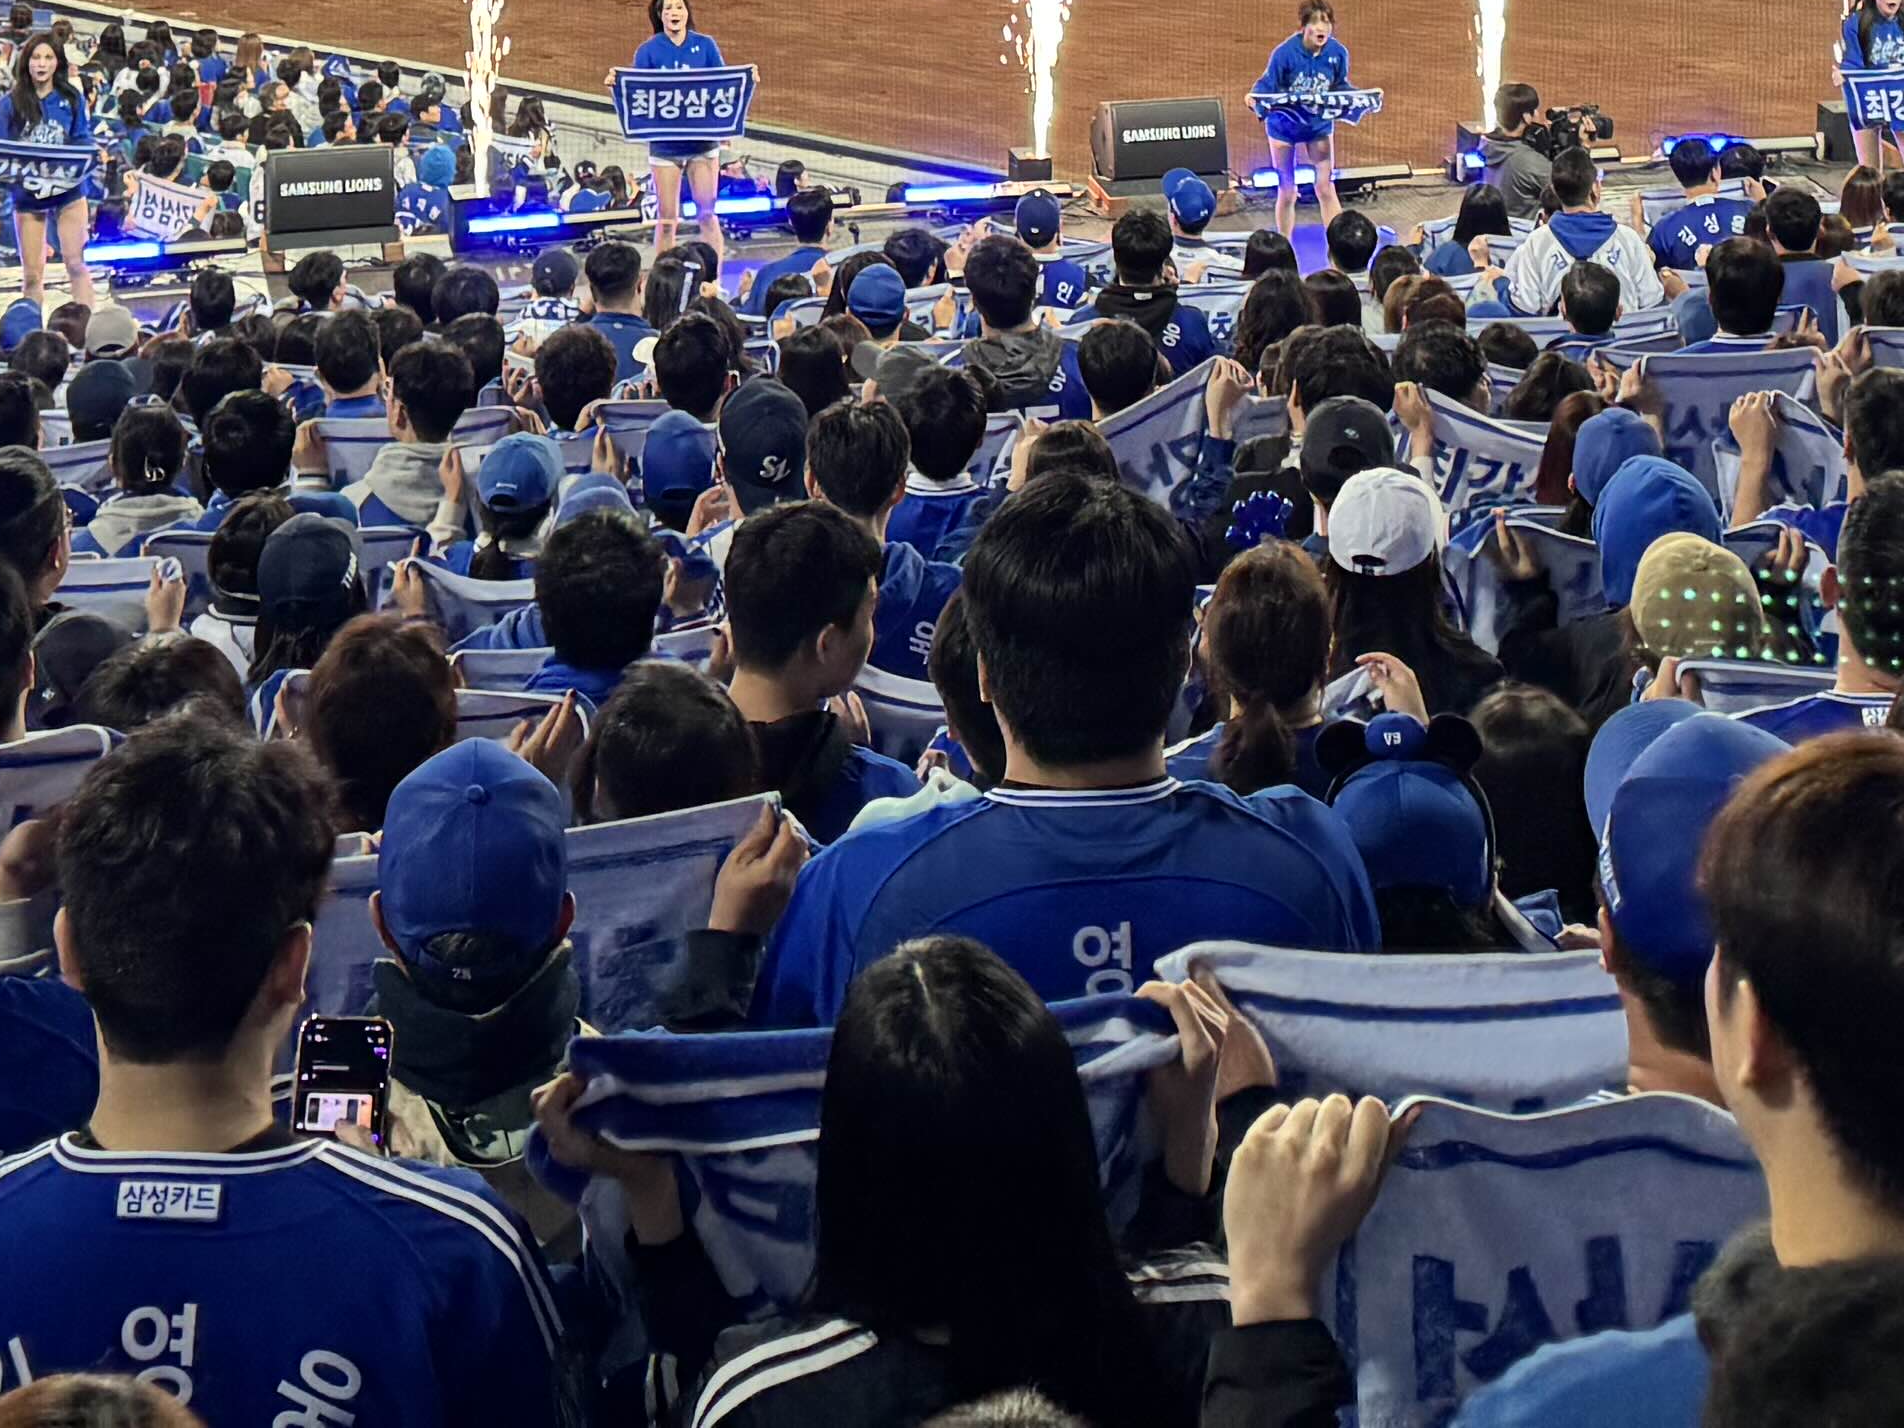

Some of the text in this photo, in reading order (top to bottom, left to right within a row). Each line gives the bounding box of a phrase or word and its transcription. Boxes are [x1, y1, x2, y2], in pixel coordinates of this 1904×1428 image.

[630, 86, 736, 121] 최강삼성
[1123, 124, 1216, 143] SAMSUNG LIONS
[279, 176, 383, 197] SAMSUNG LIONS
[122, 1185, 218, 1216] 삼성카드
